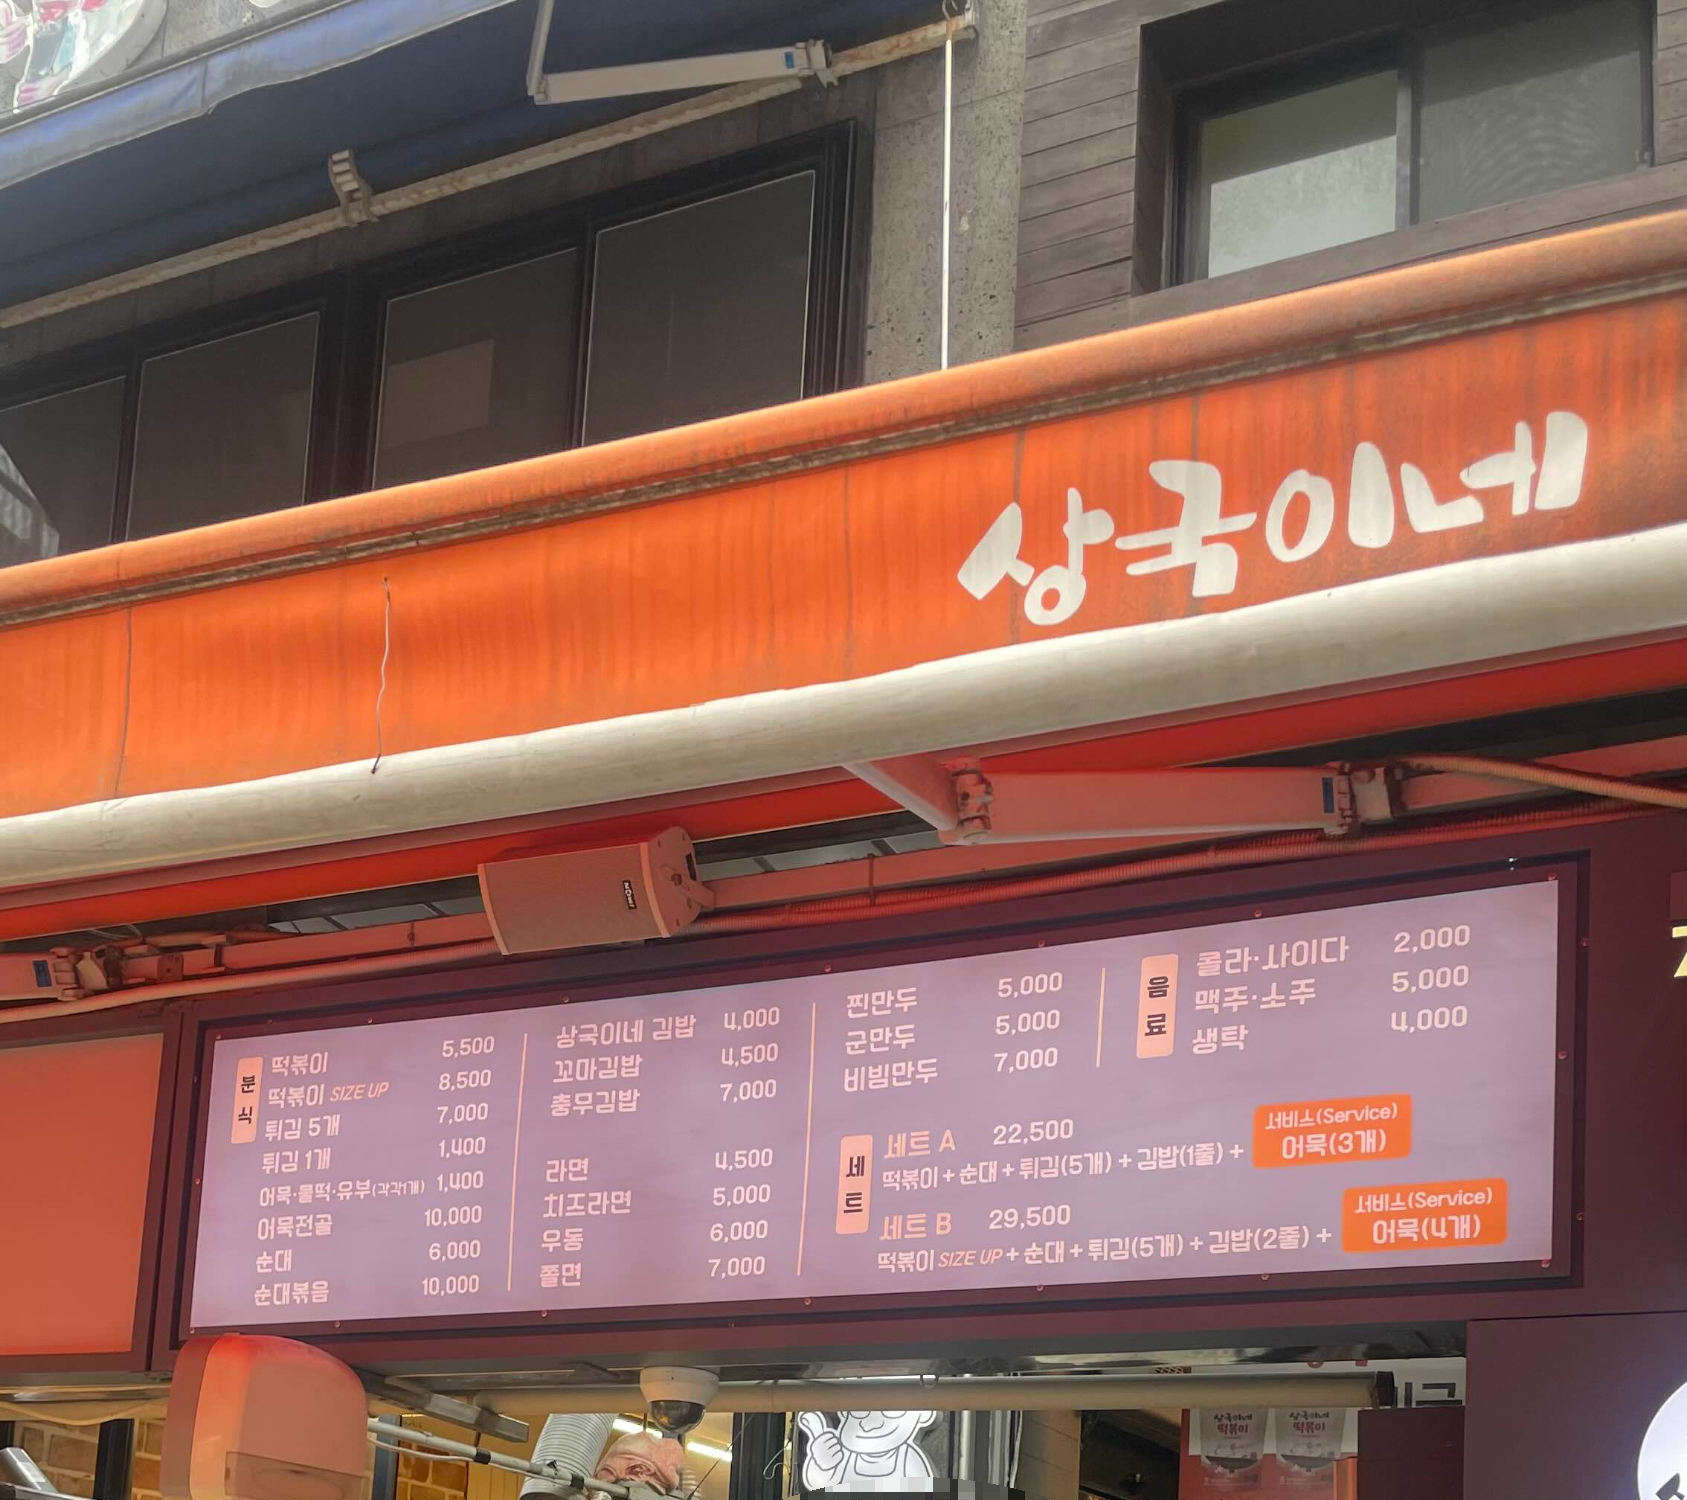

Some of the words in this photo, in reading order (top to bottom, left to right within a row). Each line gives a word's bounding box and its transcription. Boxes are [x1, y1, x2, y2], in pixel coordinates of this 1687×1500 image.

[957, 411, 1587, 626] 상국이네
[1394, 925, 1470, 953] 2,000
[846, 987, 917, 1019] 찐만두
[998, 972, 1063, 998] 5,000
[1392, 965, 1469, 993] 5,000
[556, 1019, 644, 1049] 상국이네
[652, 1015, 696, 1041] 김밥
[723, 1007, 780, 1031] 4,000
[845, 1025, 915, 1055] 군만두
[995, 1009, 1060, 1036] 5,000
[1192, 1025, 1249, 1054] 생탁
[1391, 1006, 1468, 1034] 4,000
[271, 1052, 328, 1076] 떡볶이
[442, 1036, 494, 1058] 5,500
[553, 1054, 643, 1083] 꼬마김밥
[721, 1043, 779, 1067] 4,500
[844, 1059, 938, 1092] 비빔만두
[994, 1047, 1058, 1074] 7,000
[268, 1084, 324, 1109] 떡볶이
[330, 1083, 364, 1102] SIZE
[367, 1081, 389, 1098] UP
[439, 1069, 492, 1091] 8,500
[550, 1089, 641, 1117] 충무김밥
[720, 1079, 777, 1103] 7,000
[265, 1119, 301, 1142] 튀김
[308, 1114, 341, 1137] 5개
[437, 1103, 489, 1125] 7,000
[1265, 1102, 1398, 1131] 서비스(Service)
[262, 1151, 299, 1174] 튀김
[304, 1148, 331, 1170] 1개
[438, 1137, 486, 1159] 1,400
[884, 1130, 930, 1159] 세트
[939, 1130, 956, 1152] A
[993, 1118, 1074, 1146] 22,500
[1281, 1129, 1387, 1159] 어묵(3개)
[436, 1171, 484, 1193] 1,400
[546, 1158, 589, 1183] 라면
[715, 1148, 773, 1171] 4,500
[882, 1167, 938, 1191] 떡볶이
[959, 1161, 997, 1185] 순대
[543, 1190, 632, 1218] 치즈라면
[713, 1184, 771, 1208] 5,000
[1355, 1187, 1493, 1214] 서비스(Service)
[257, 1214, 333, 1240] 어묵전골
[424, 1205, 483, 1227] 10,000
[541, 1228, 584, 1253] 우동
[710, 1220, 768, 1243] 6,000
[880, 1213, 926, 1240] 세트
[936, 1213, 952, 1235] B
[989, 1204, 1071, 1230] 29,500
[1372, 1213, 1481, 1244] 어묵(4개)
[256, 1249, 292, 1273] 순대
[428, 1240, 481, 1262] 6,000
[539, 1262, 582, 1288] 쫄면
[708, 1256, 765, 1280] 7,000
[878, 1249, 934, 1273] 떡볶이
[938, 1250, 976, 1268] SIZE
[1024, 1241, 1064, 1265] 순대
[254, 1280, 329, 1306] 순대볶음
[421, 1274, 480, 1296] 10,000
